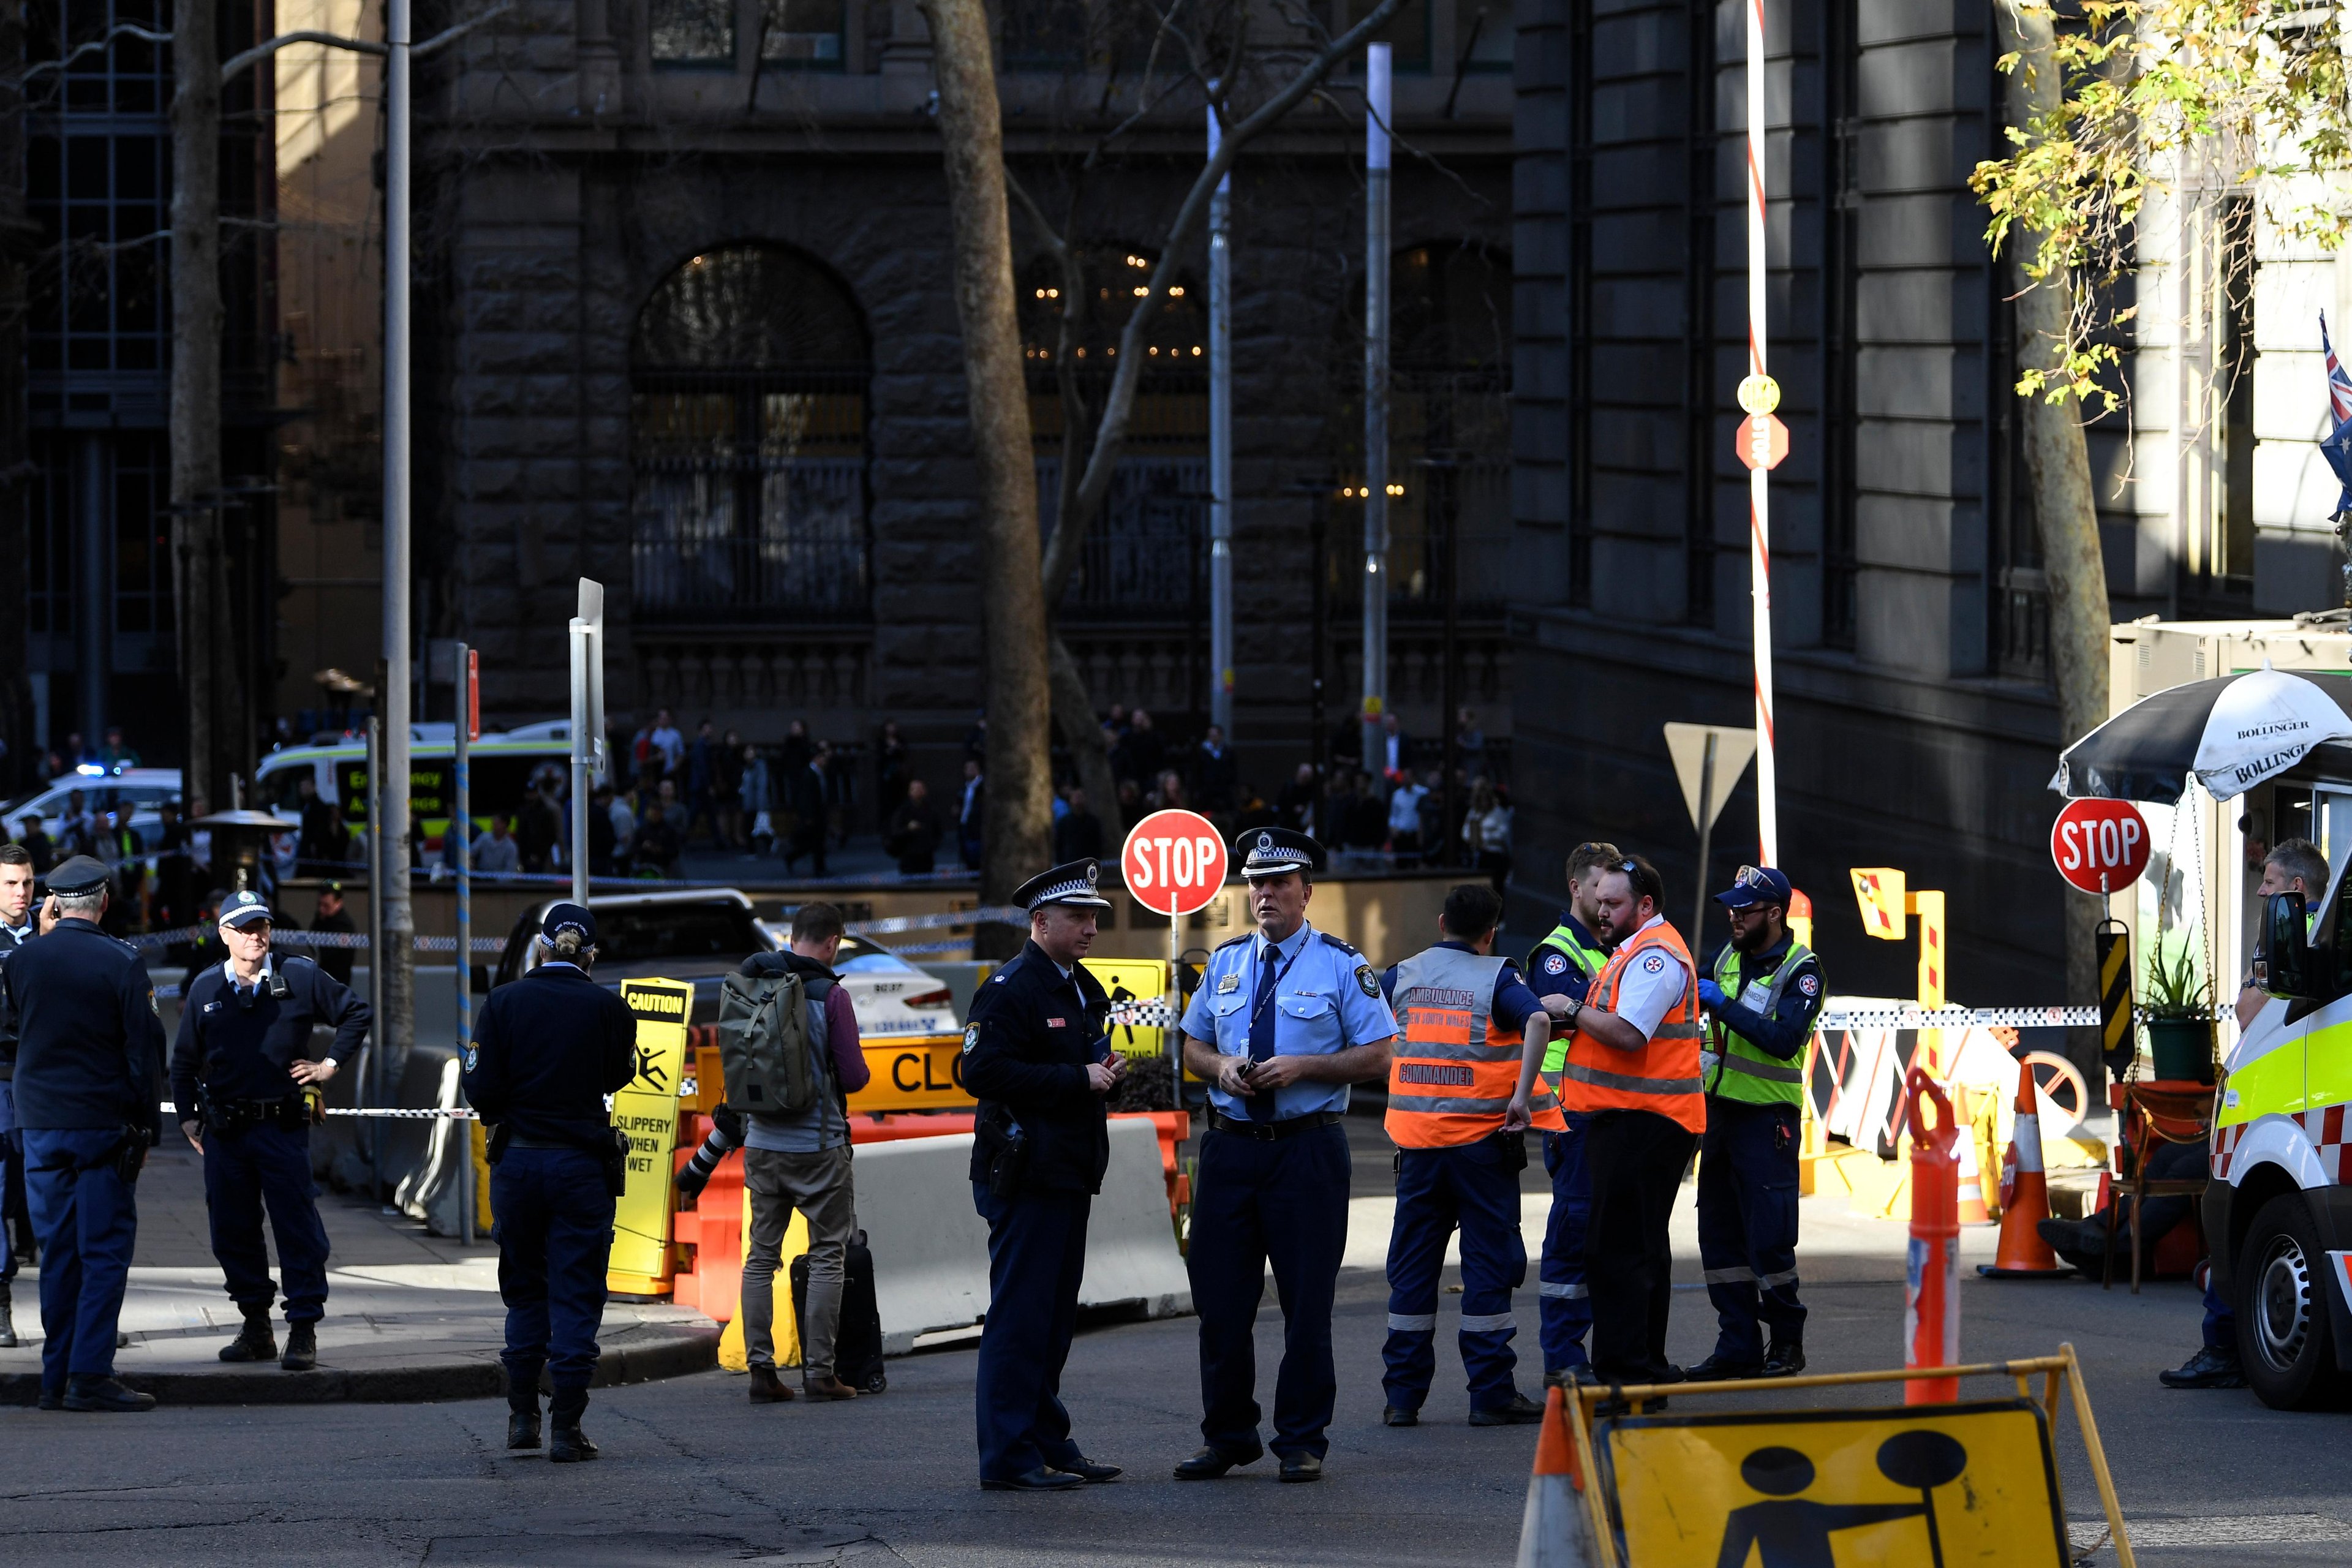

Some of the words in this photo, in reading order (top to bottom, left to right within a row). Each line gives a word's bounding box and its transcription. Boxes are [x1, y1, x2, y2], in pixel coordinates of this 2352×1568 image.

[1752, 417, 1770, 466] STOP
[2237, 721, 2309, 739] BOLLINGER
[2061, 817, 2140, 870] STOP
[1133, 837, 1216, 888] STOP
[578, 924, 588, 936] FORCE
[627, 992, 684, 1014] CAUTION
[1409, 987, 1474, 1006] AMBULANCE
[1421, 1012, 1444, 1025] SOUTH
[1446, 1015, 1470, 1028] WALES
[1399, 1063, 1474, 1087] COMMANDER
[616, 1115, 671, 1134] SLIPPERY
[629, 1136, 658, 1153] WHEN
[628, 1156, 652, 1172] WET
